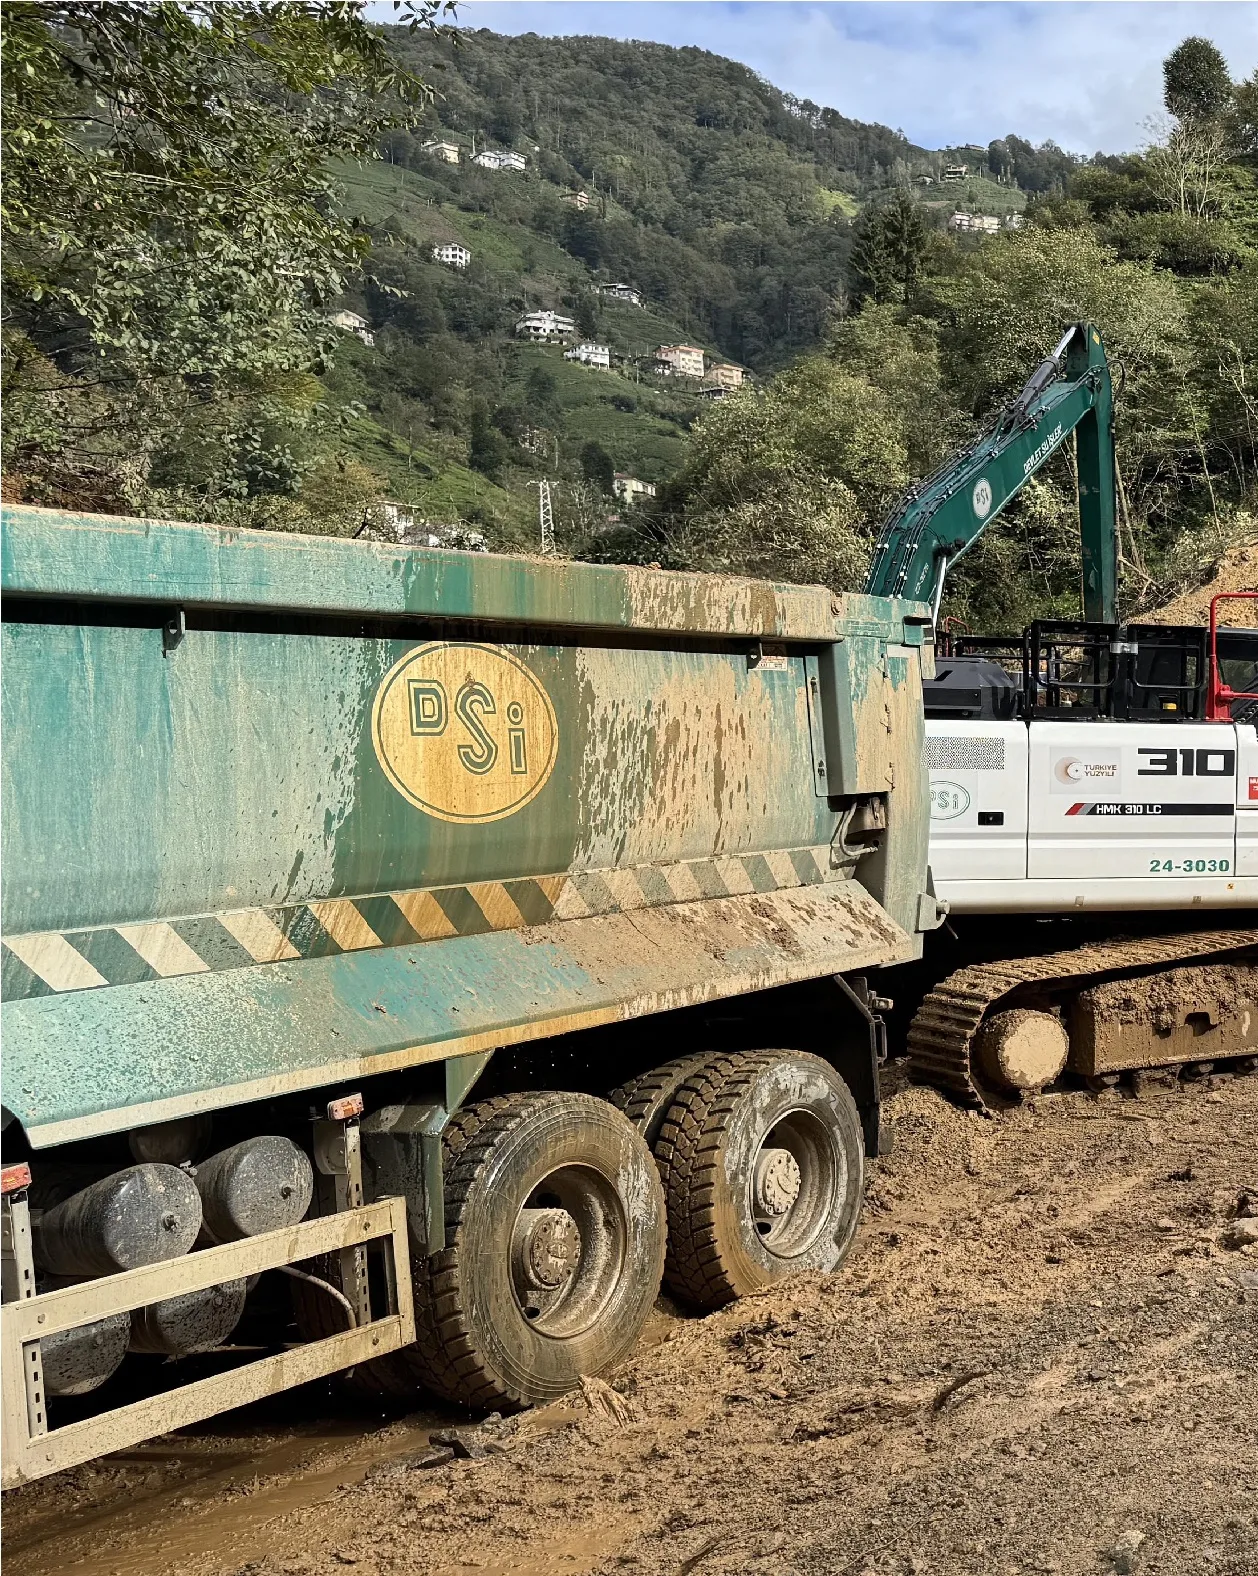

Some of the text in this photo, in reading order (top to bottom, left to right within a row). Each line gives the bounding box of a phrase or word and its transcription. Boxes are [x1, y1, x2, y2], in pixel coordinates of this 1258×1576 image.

[1137, 747, 1236, 777] 310
[1096, 804, 1162, 815] HMK 310 LC
[1149, 859, 1230, 873] 24-3030
